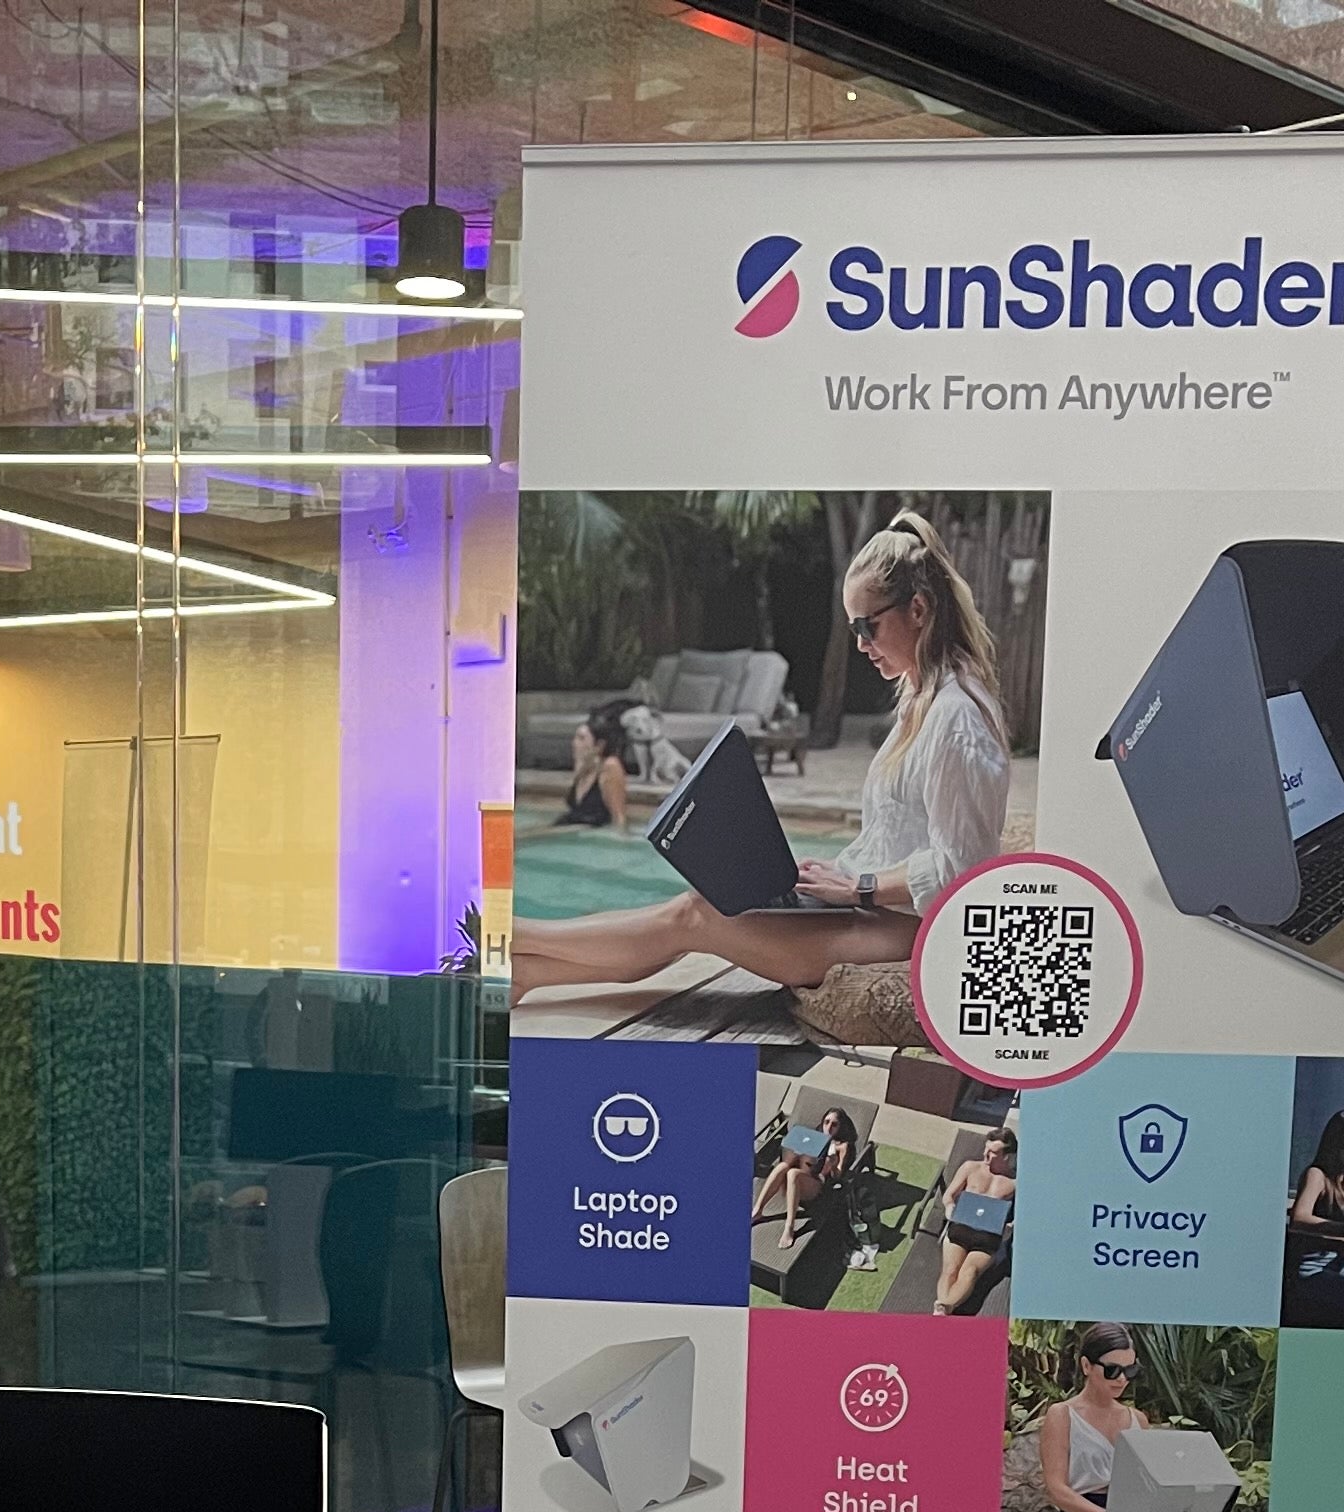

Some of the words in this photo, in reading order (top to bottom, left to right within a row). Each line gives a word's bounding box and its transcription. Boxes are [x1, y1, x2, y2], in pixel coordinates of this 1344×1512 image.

[824, 374, 930, 412] Work
[943, 375, 1048, 412] From
[1003, 883, 1037, 895] SCAN
[1040, 884, 1058, 895] ME
[995, 1049, 1029, 1060] SCAN
[1032, 1049, 1050, 1061] ME
[574, 1186, 678, 1221] Laptop
[1092, 1203, 1207, 1238] Privacy
[579, 1222, 670, 1250] Shade
[1093, 1241, 1199, 1269] Screen
[859, 1388, 889, 1407] 69
[837, 1456, 908, 1482] Heat
